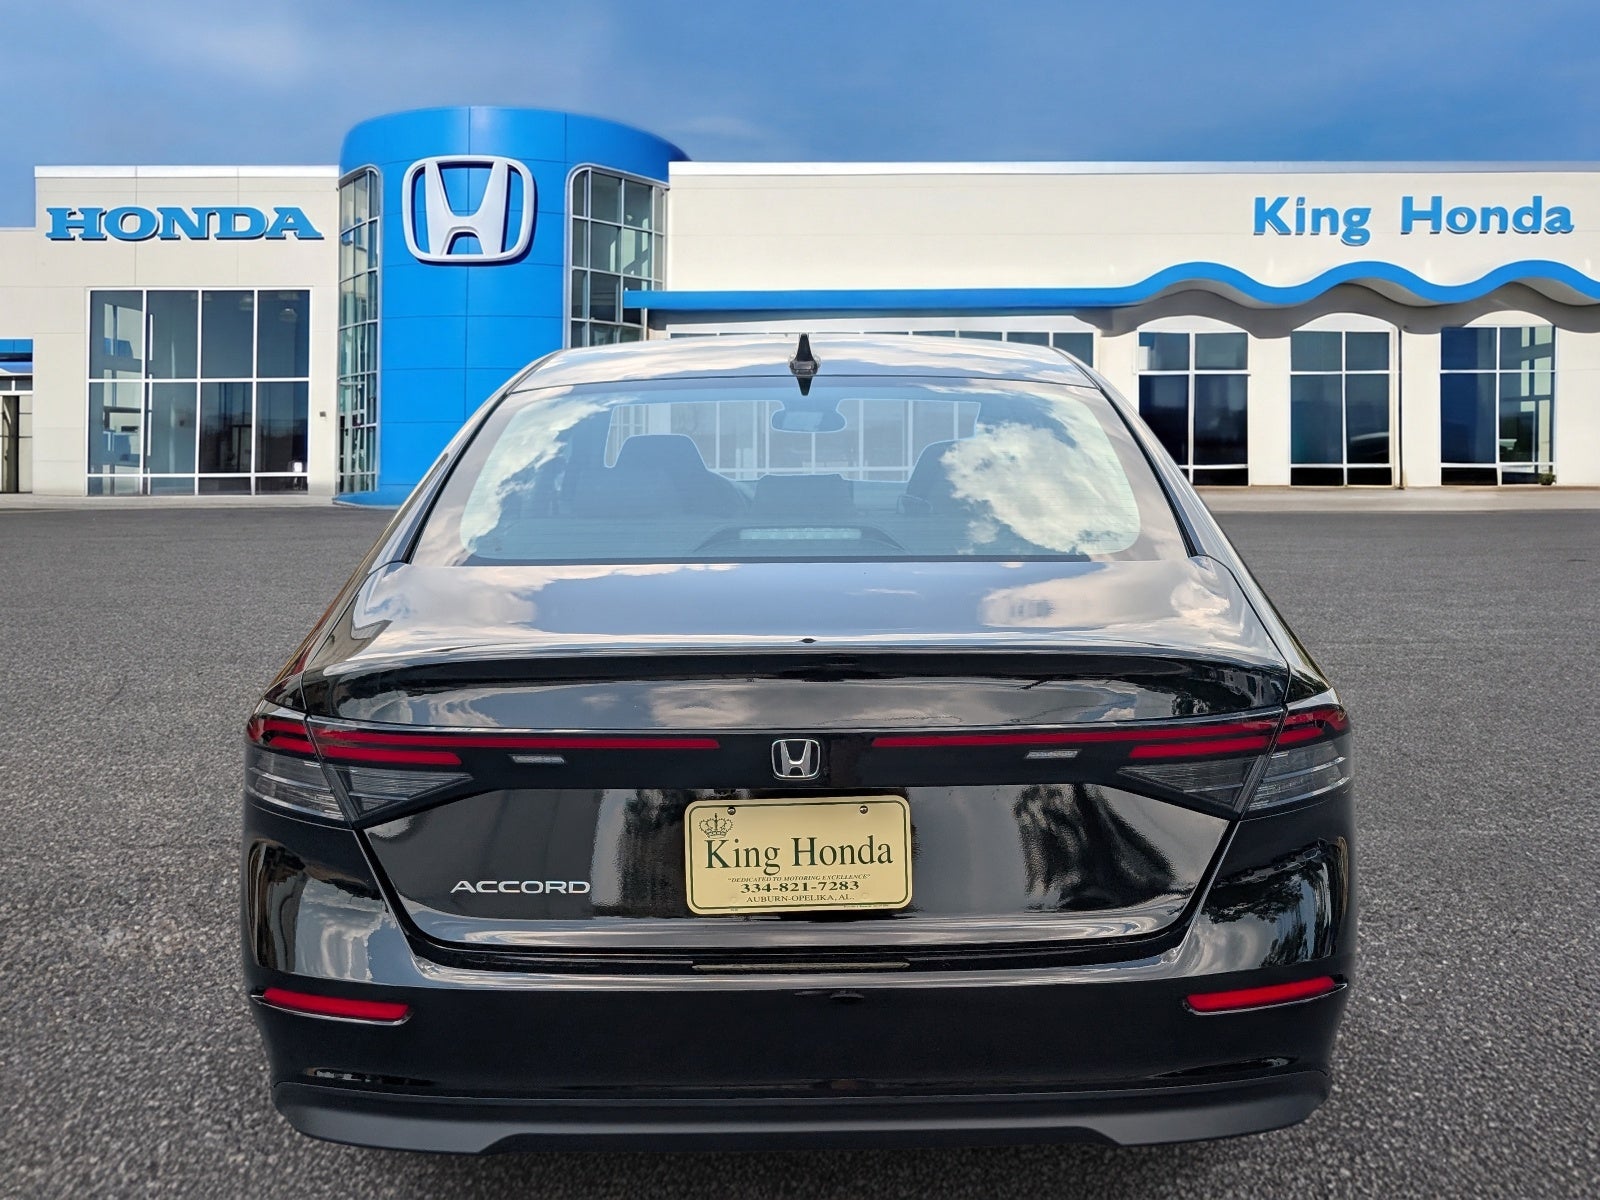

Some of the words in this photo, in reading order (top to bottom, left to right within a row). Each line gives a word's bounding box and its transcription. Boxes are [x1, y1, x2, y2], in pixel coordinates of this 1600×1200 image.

[45, 206, 325, 241] HONDA
[1253, 196, 1371, 246] King
[1400, 195, 1574, 235] Honda
[704, 838, 781, 876] King
[791, 834, 894, 867] Honda
[450, 880, 591, 894] ACCORD
[740, 881, 860, 893] 334-821-7283
[746, 894, 837, 903] AUBURN-OPELIKA,
